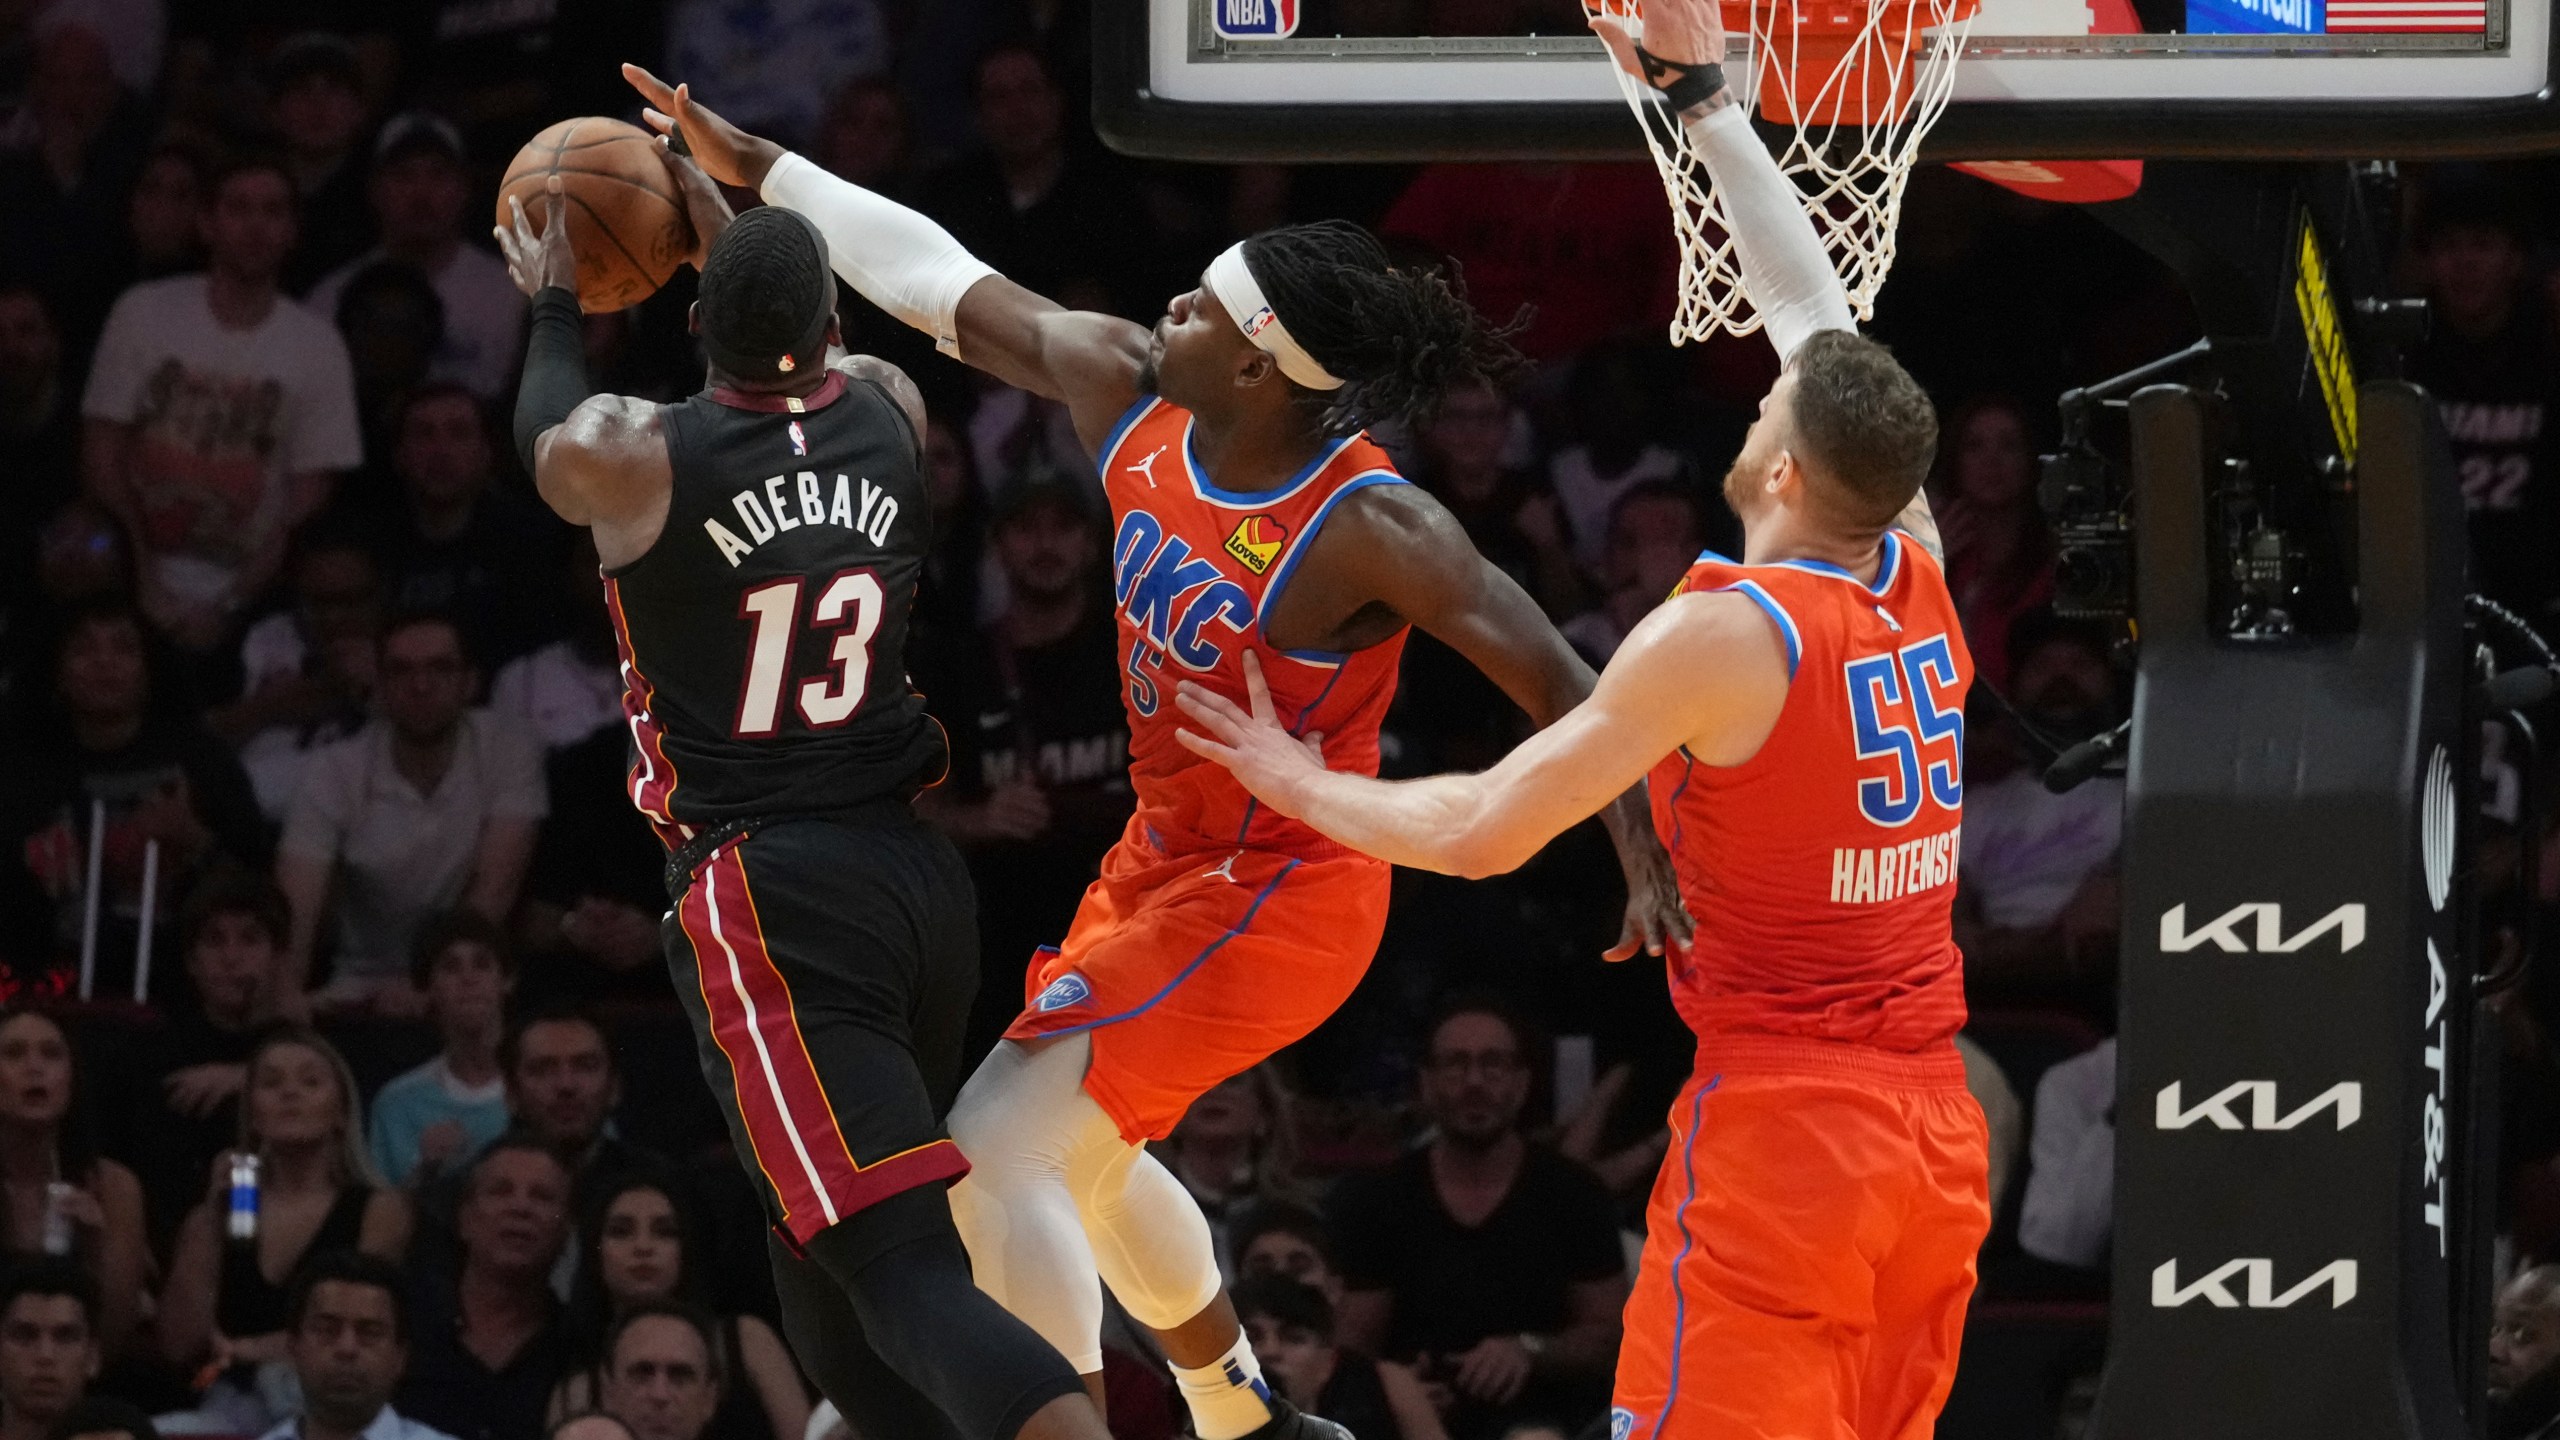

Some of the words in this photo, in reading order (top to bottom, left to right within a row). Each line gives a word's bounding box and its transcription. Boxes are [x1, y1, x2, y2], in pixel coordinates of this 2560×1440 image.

[1226, 0, 1266, 25] NBA
[703, 471, 898, 568] ADEBAYO
[2459, 455, 2531, 509] 22
[1114, 509, 1255, 672] OKC
[731, 566, 886, 739] 13
[1127, 637, 1159, 718] 5
[1844, 632, 1964, 828] 55
[1830, 825, 1961, 904] HARTENST
[2159, 902, 2366, 954] KIA
[2156, 1080, 2362, 1132] KIA
[2424, 936, 2447, 1259] AT&T
[2152, 1258, 2358, 1309] KIA
